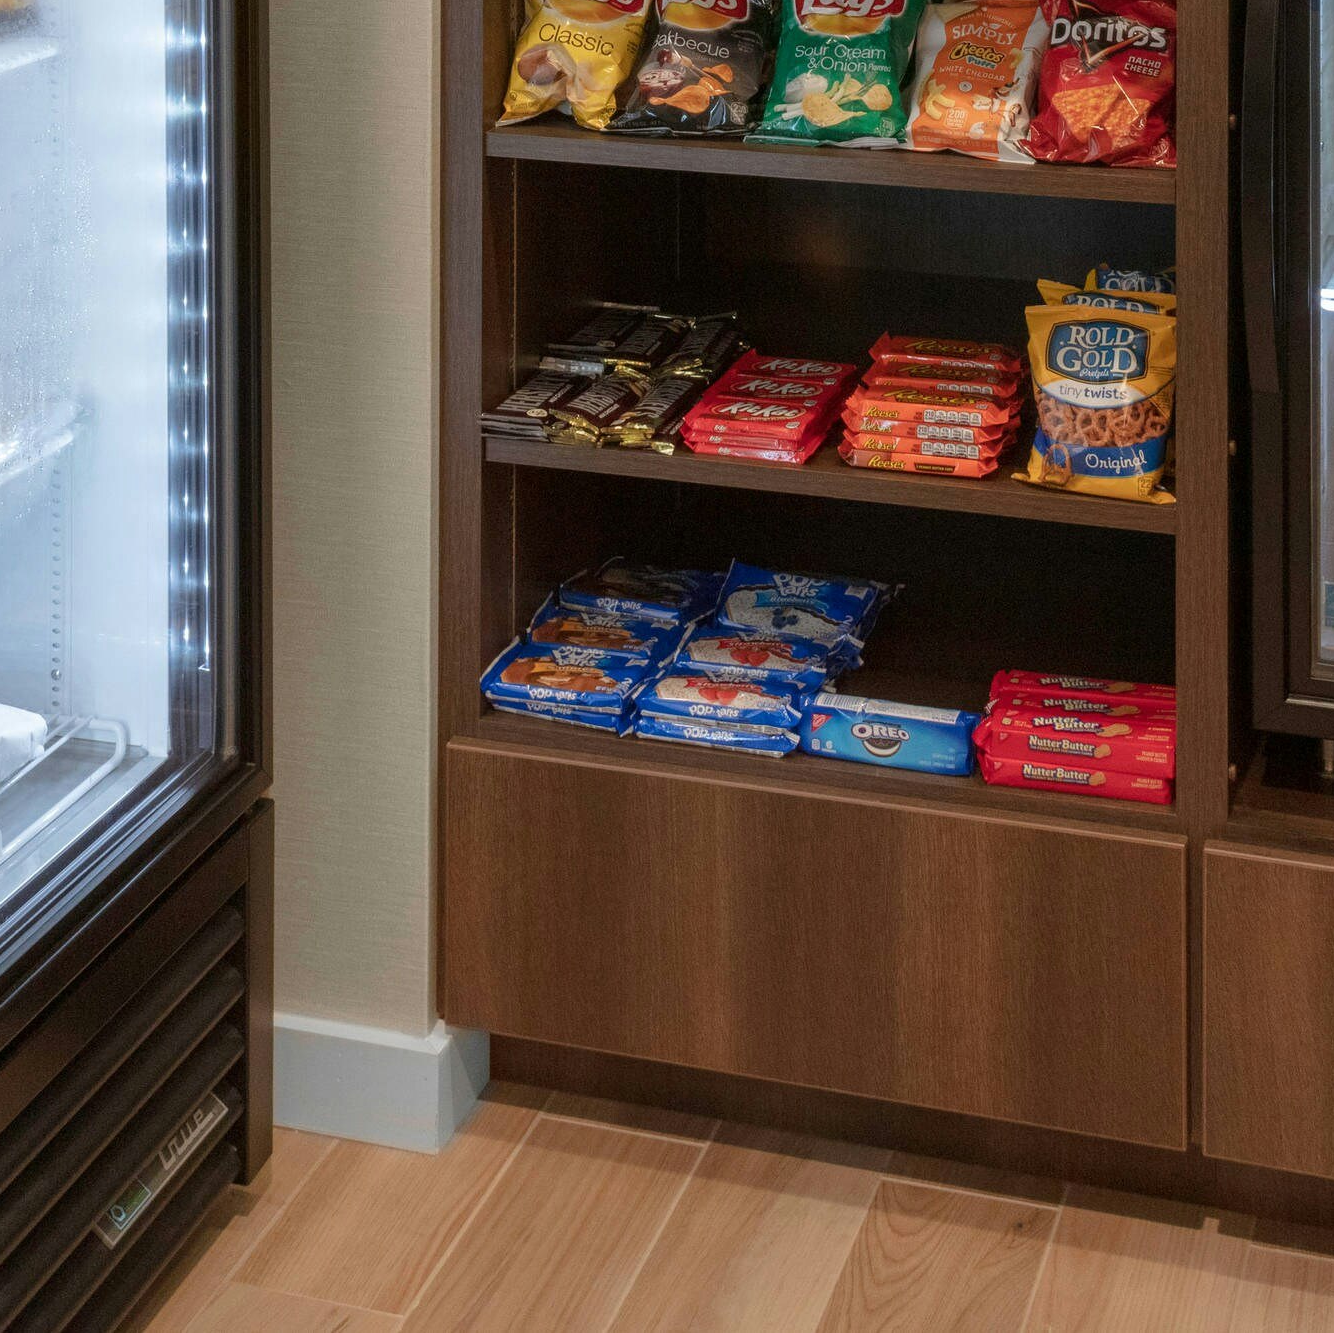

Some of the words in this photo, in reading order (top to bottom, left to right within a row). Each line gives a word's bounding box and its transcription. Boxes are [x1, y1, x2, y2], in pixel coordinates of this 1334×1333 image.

[538, 22, 615, 57] Classic
[952, 23, 1017, 47] SIMPLY
[1050, 17, 1168, 50] Doritos
[794, 43, 829, 60] Sour
[838, 43, 887, 60] Cream
[949, 42, 1006, 64] Cheetos
[1124, 63, 1161, 78] CHEESE
[1128, 55, 1162, 69] NACHO
[939, 66, 963, 75] WHITE
[966, 68, 1005, 82] CHEDDAR
[1069, 324, 1135, 350] ROLD
[1056, 346, 1138, 375] GOLD
[1079, 367, 1110, 379] Pretzels
[1059, 385, 1083, 398] tiny
[1084, 386, 1128, 401] twists
[1084, 449, 1148, 474] Original
[851, 722, 911, 742] OREO
[1029, 735, 1061, 749] Nutter
[1062, 739, 1095, 753] Butter
[1022, 763, 1056, 777] Nutter
[1056, 767, 1091, 781] Butter
